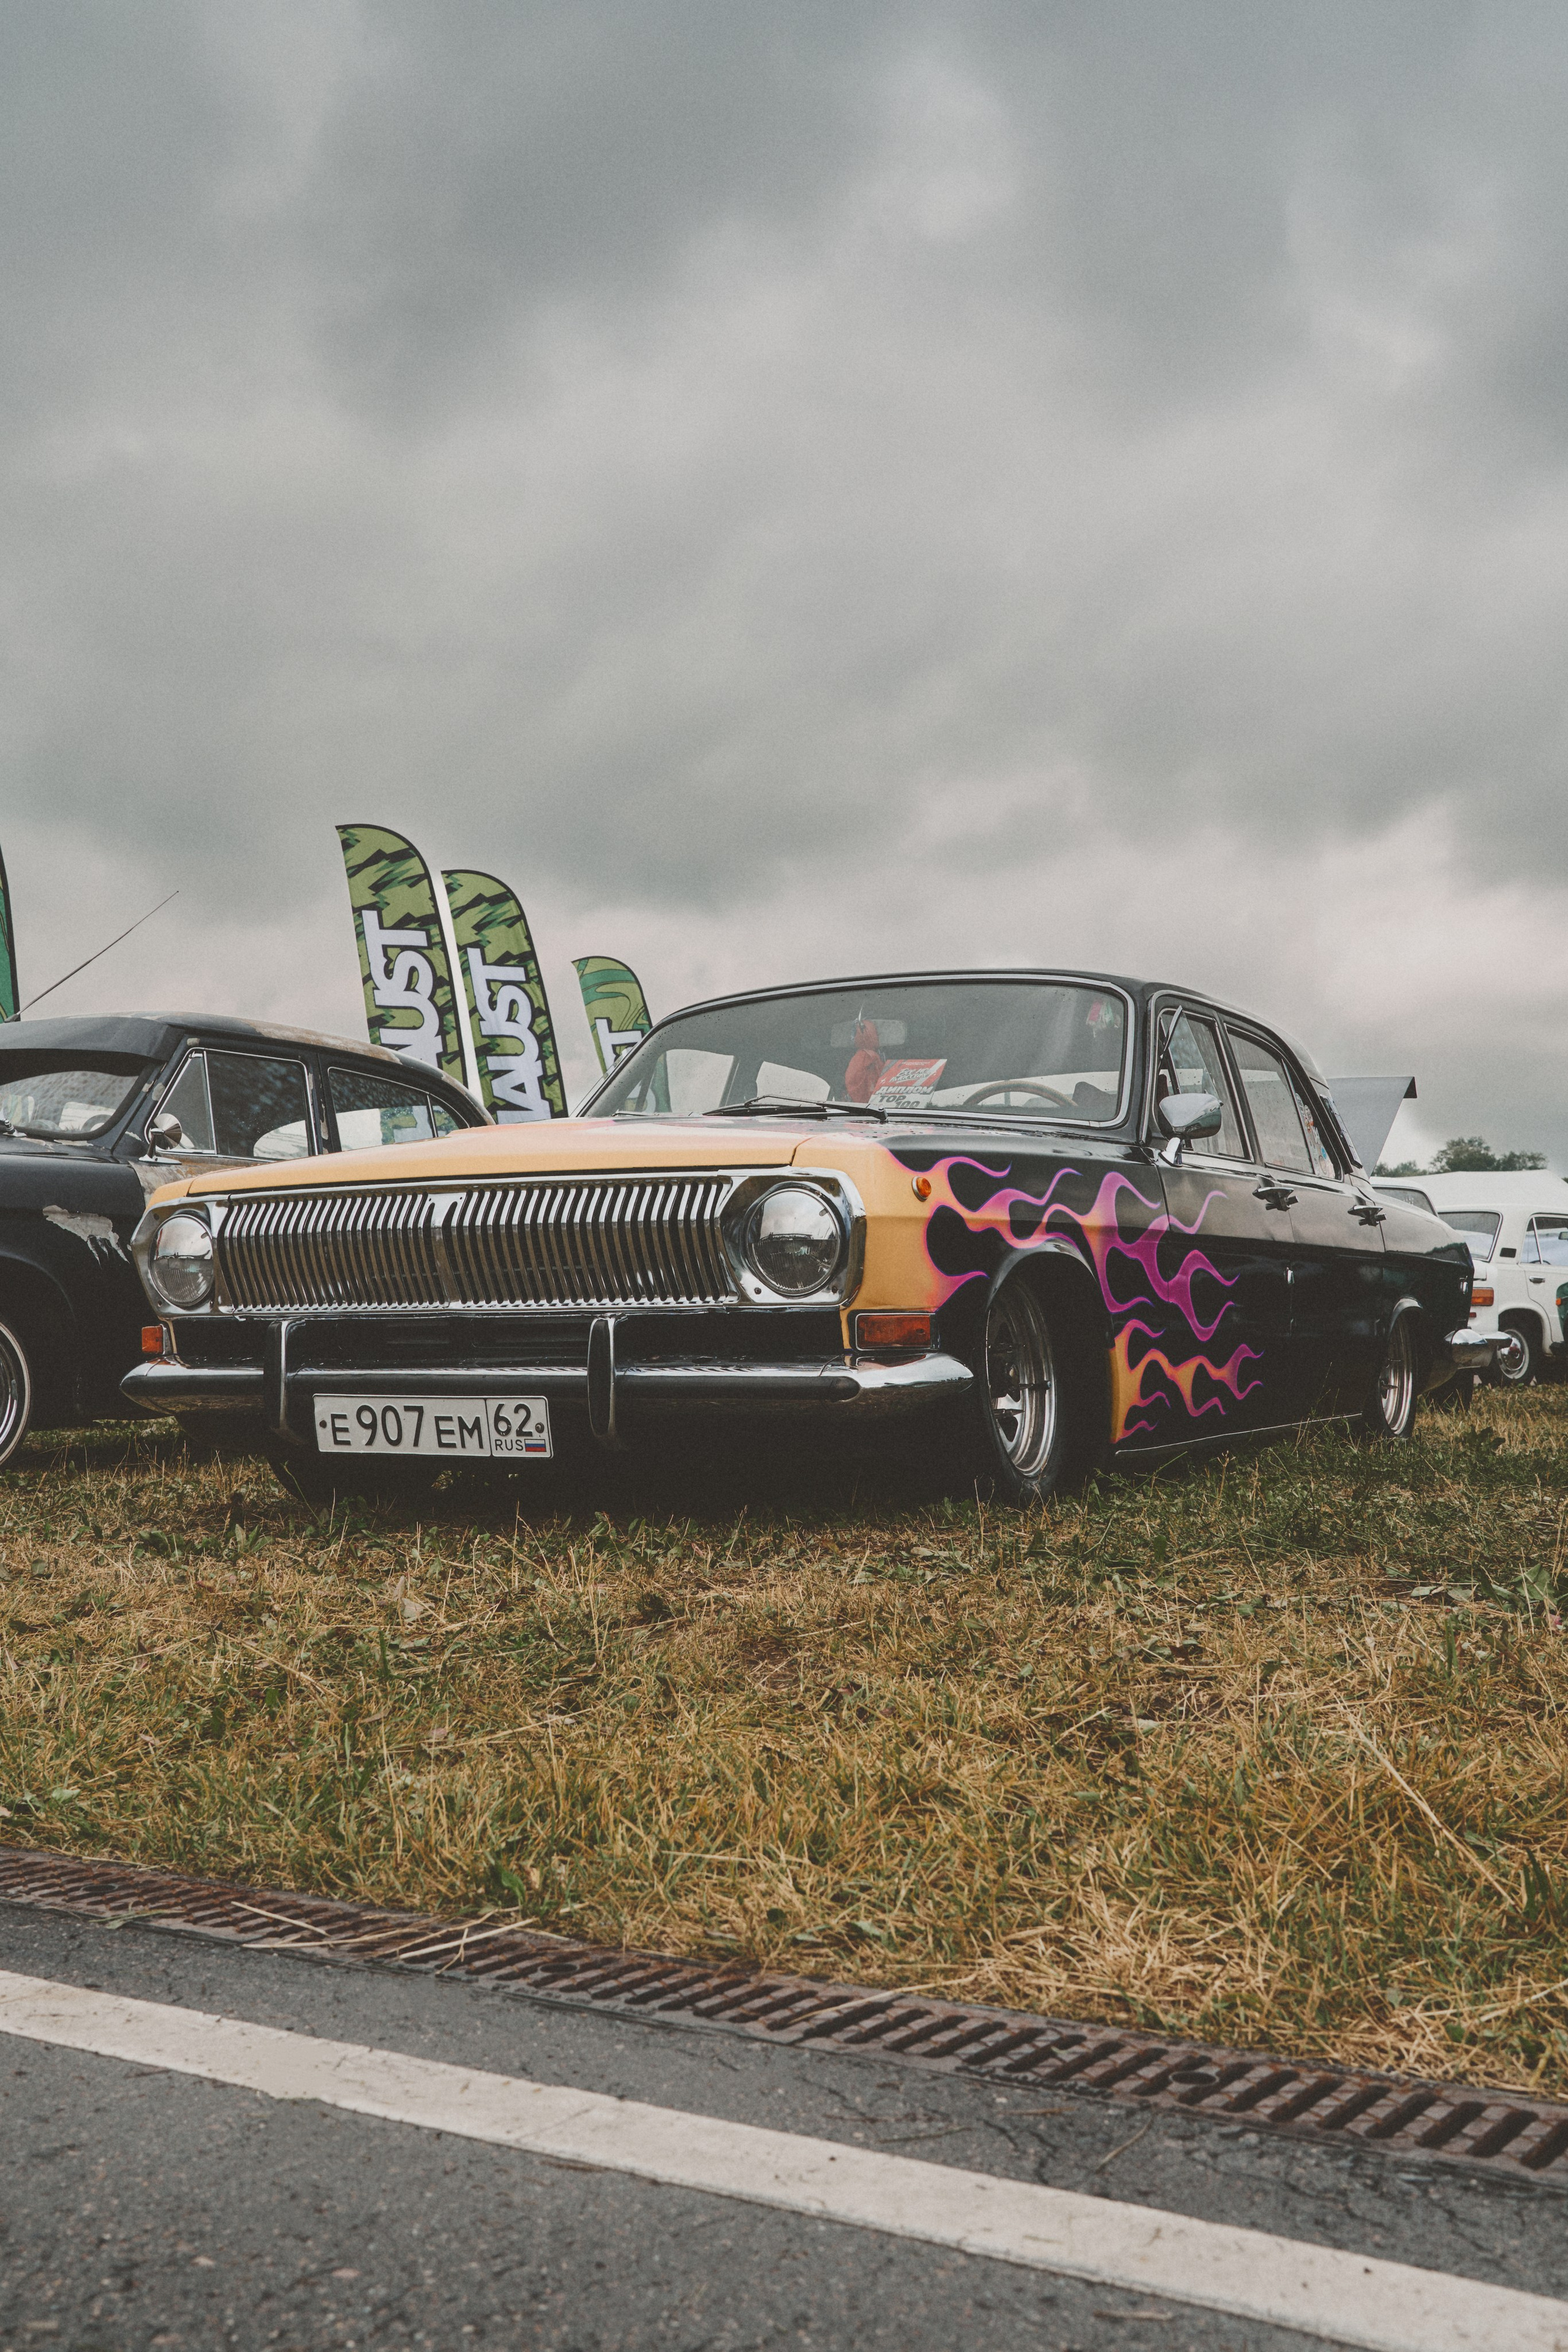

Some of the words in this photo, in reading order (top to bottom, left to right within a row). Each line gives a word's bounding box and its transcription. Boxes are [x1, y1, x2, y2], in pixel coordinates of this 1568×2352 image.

[875, 1086, 934, 1095] ДИПЛОМ
[494, 1403, 533, 1437] 62
[495, 1439, 524, 1452] RUS
